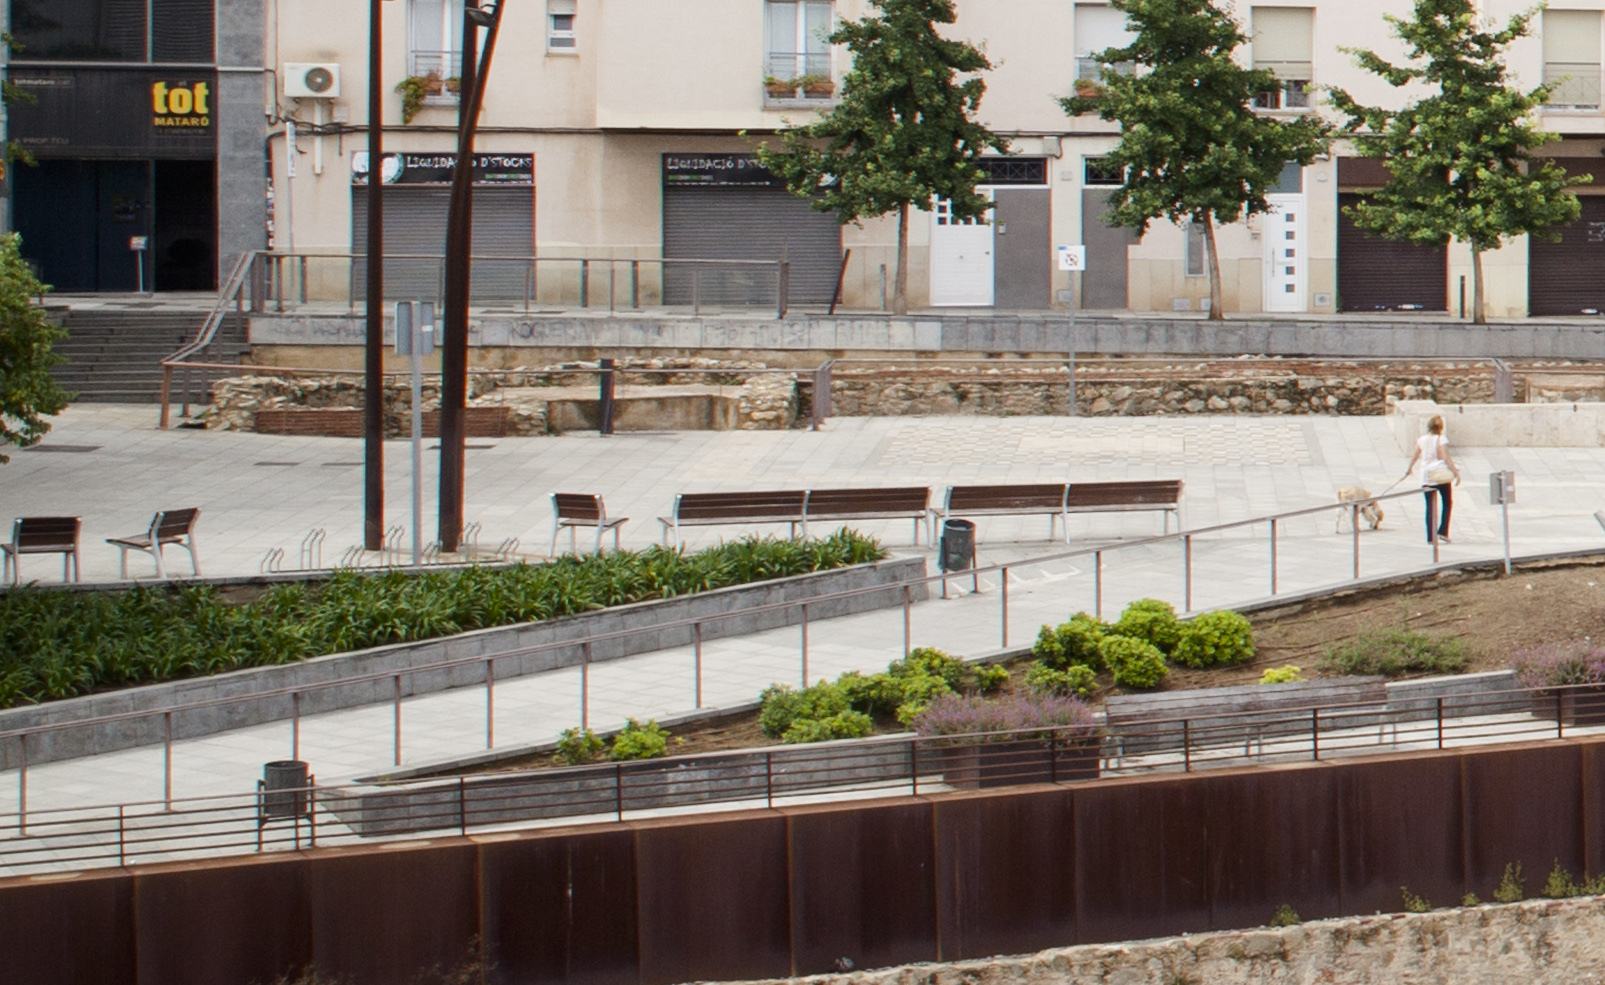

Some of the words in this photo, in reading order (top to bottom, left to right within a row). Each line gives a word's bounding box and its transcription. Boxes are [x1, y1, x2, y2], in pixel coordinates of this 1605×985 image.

[153, 81, 209, 114] tot
[153, 116, 209, 127] MATARÓ
[666, 157, 735, 170] LIQUIDACIÓ
